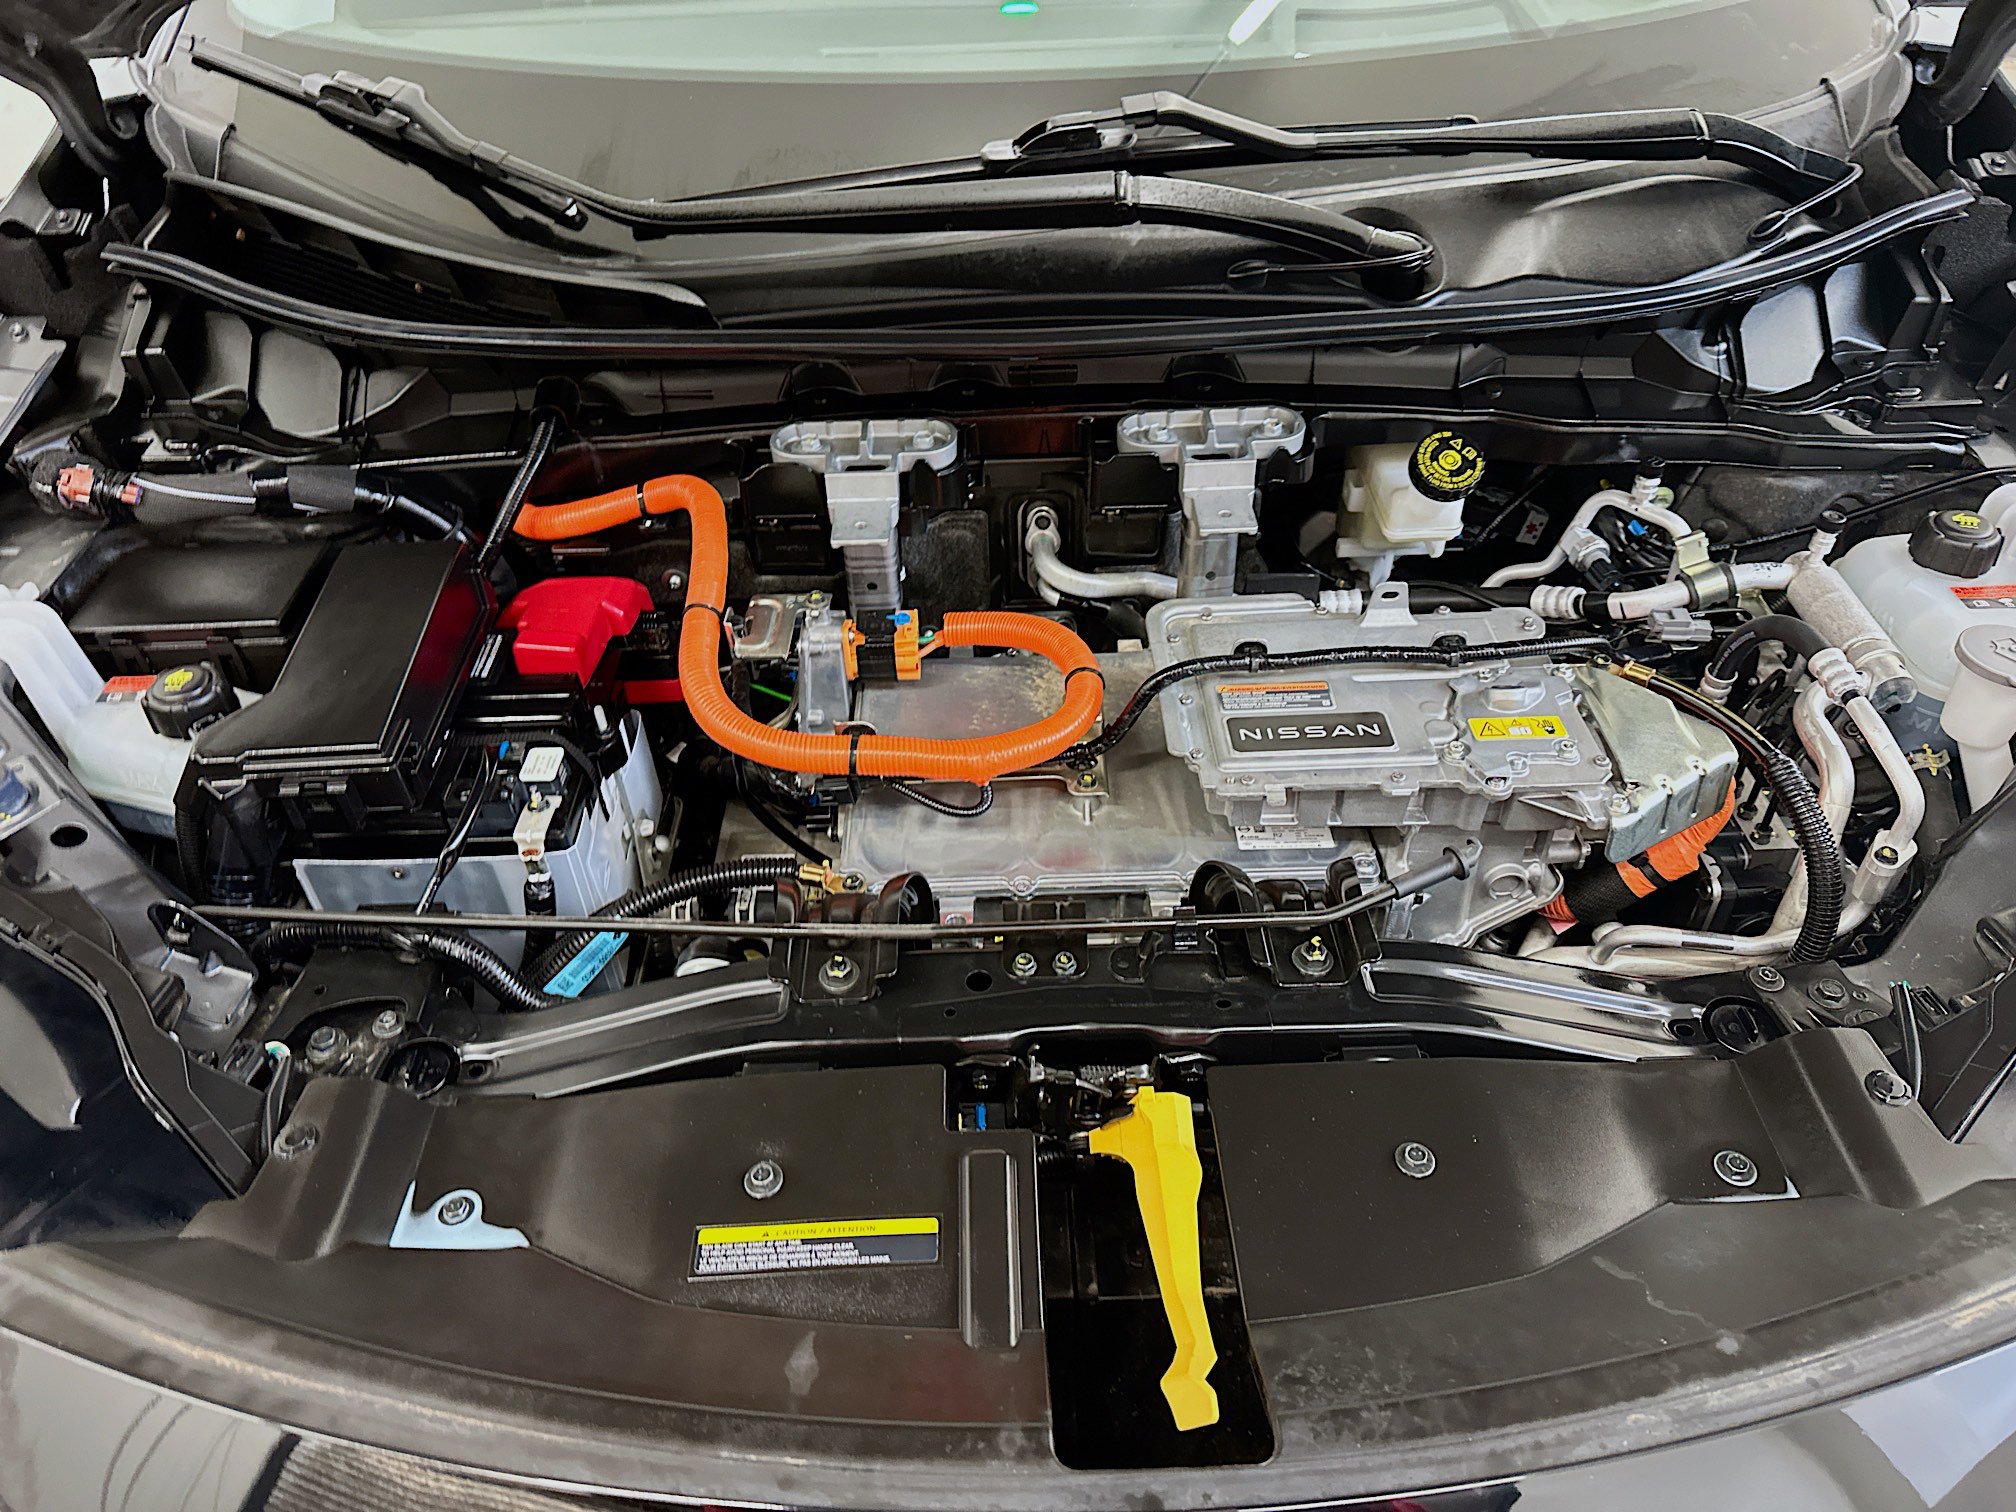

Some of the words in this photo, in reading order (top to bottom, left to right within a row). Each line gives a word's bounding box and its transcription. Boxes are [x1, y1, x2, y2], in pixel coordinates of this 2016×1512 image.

[1239, 723, 1381, 741] NISSAN
[775, 1228, 817, 1237] CAUTION
[827, 1225, 876, 1234] ATTENTION
